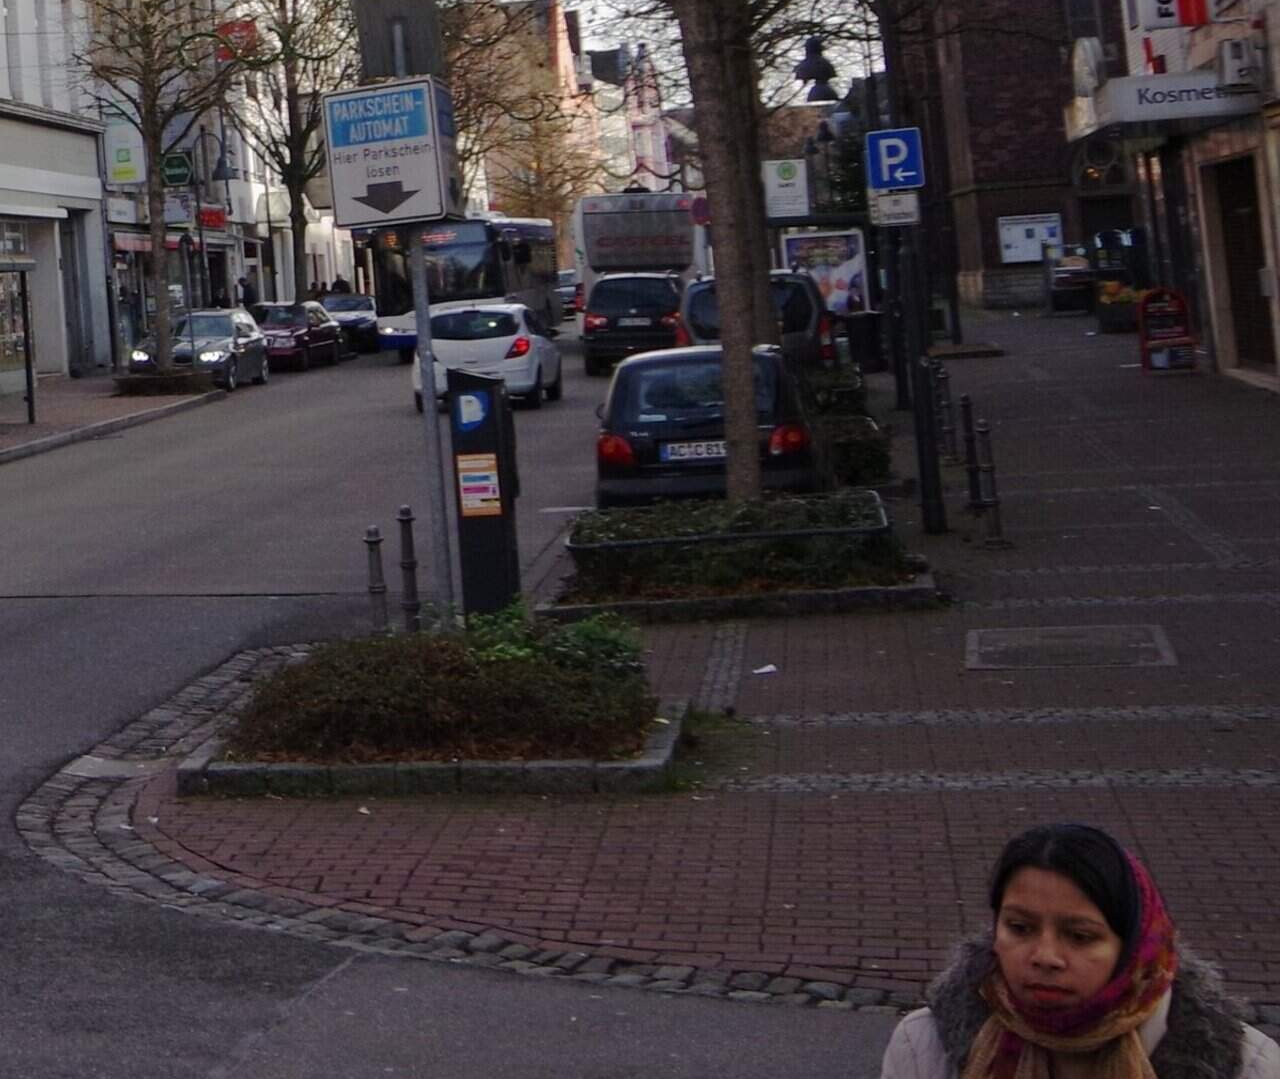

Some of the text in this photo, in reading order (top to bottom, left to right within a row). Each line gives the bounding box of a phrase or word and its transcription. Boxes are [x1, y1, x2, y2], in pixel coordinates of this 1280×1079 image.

[333, 92, 424, 121] PARKSCHEIN-
[349, 116, 409, 143] AUTOMAT
[333, 151, 358, 165] Hier
[879, 137, 908, 182] P
